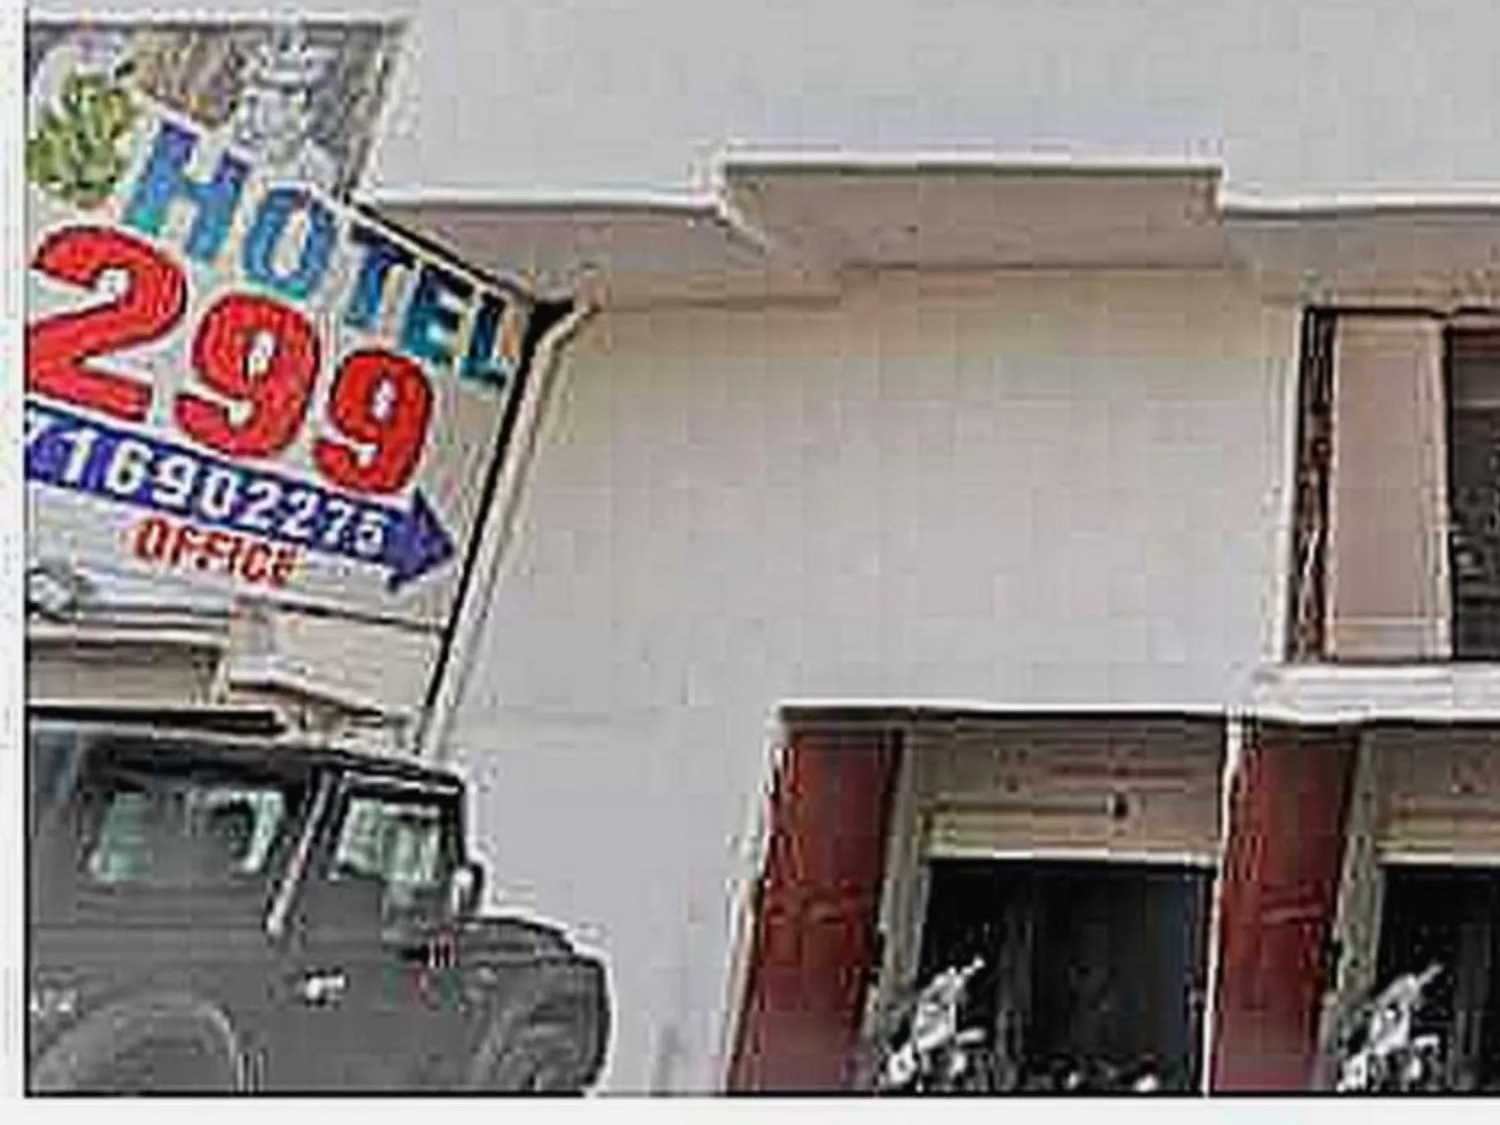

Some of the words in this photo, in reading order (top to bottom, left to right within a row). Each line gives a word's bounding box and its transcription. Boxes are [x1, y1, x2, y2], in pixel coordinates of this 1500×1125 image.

[25, 223, 434, 497] 299
[122, 118, 512, 387] HOTEL
[130, 513, 306, 589] OFFICE
